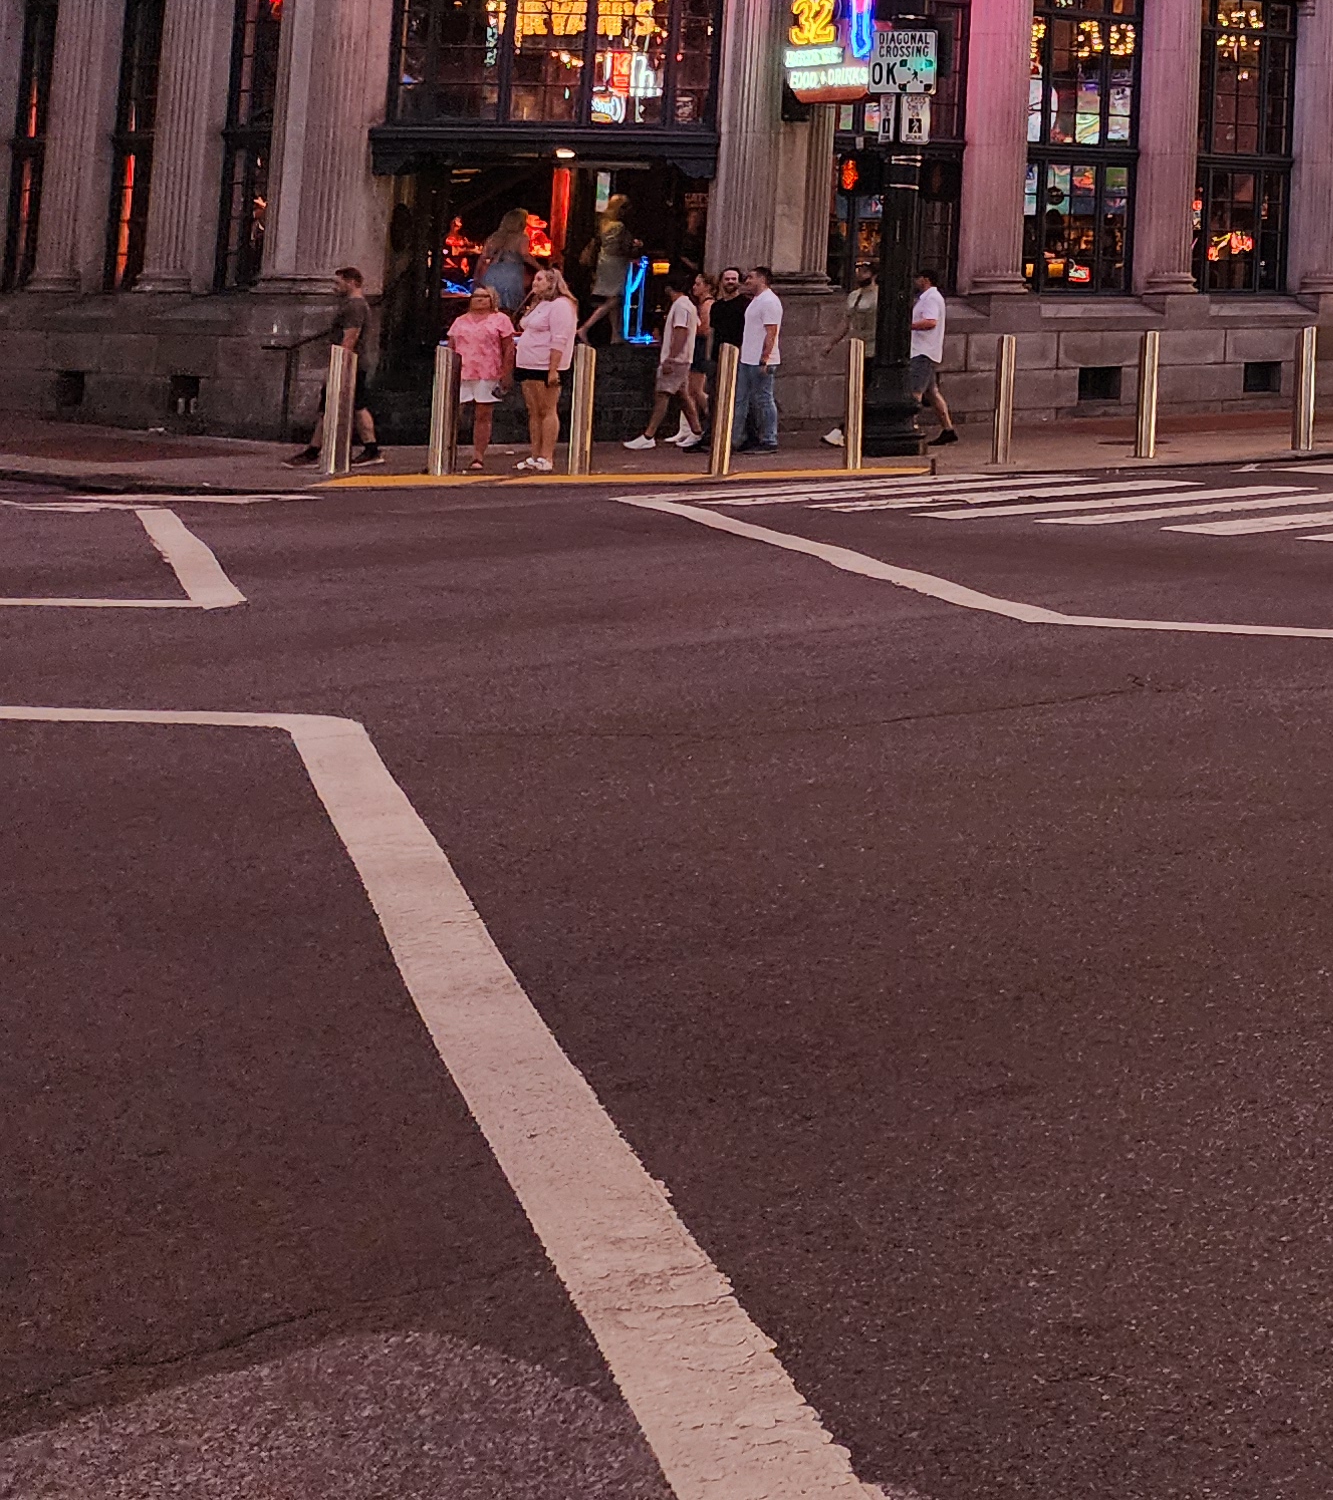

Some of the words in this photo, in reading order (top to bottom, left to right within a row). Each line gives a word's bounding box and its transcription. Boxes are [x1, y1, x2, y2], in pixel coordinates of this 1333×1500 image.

[878, 32, 931, 46] DIAGONAL
[878, 45, 930, 58] CROSSING
[872, 61, 898, 86] OK
